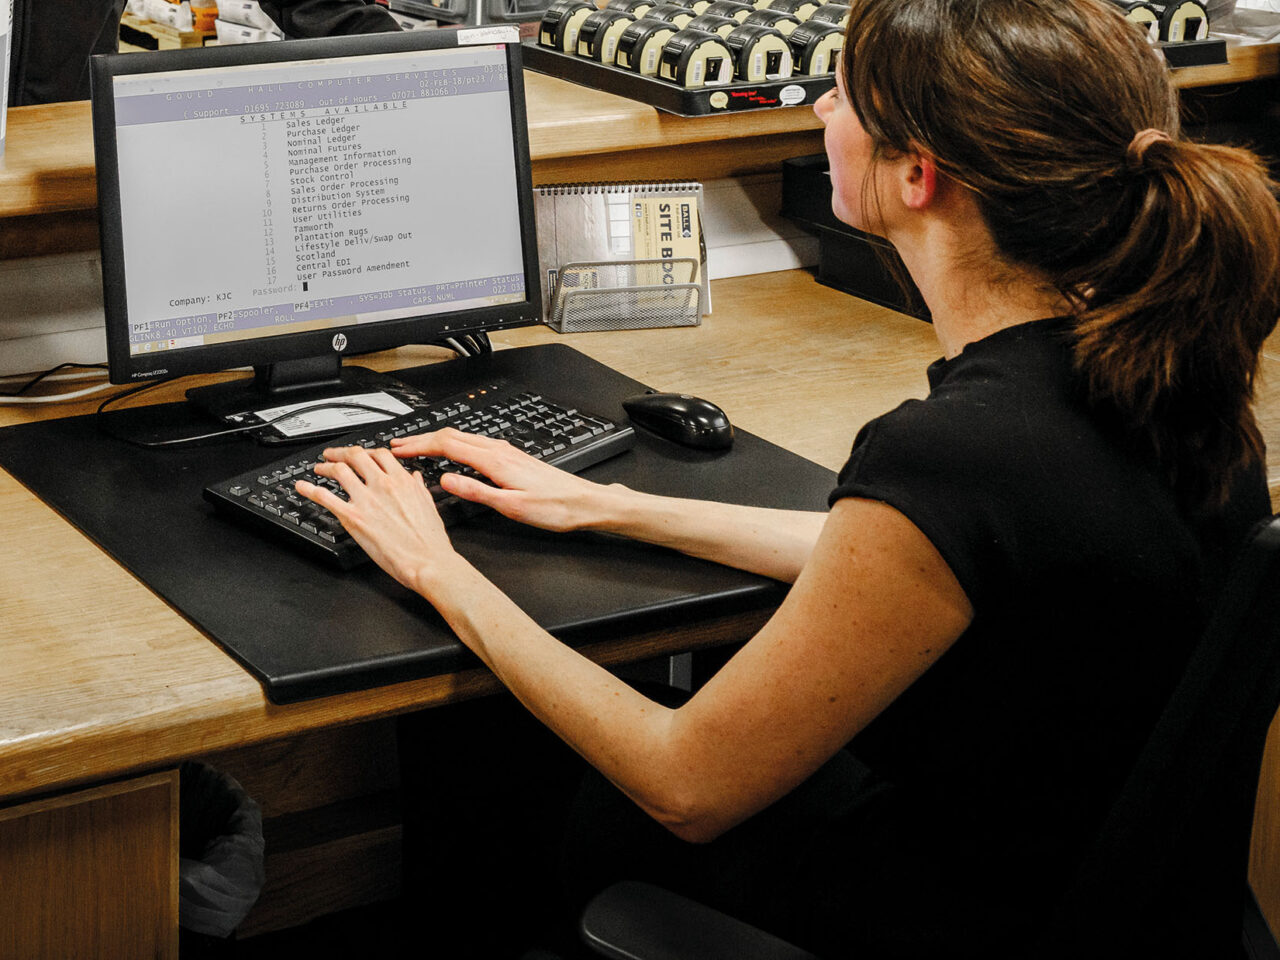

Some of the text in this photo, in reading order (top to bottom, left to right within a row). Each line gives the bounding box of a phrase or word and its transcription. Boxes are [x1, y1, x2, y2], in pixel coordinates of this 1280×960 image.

[166, 70, 458, 101] GOULD HALL COMPUTER SERVICES
[194, 108, 229, 119] Support
[240, 101, 408, 124] SYSTEMS AVAILABLE
[286, 116, 346, 129] Sales Ledger
[287, 124, 361, 138] Purchase Ledger
[288, 134, 357, 147] Nominal Ledger
[288, 144, 362, 157] Nominal Futures
[288, 150, 397, 167] Management Information
[290, 157, 412, 176] Purchase Order Processing
[290, 172, 354, 186] Stock Control
[291, 177, 399, 195] Sales Order Processing
[292, 188, 386, 205] Distribution System
[292, 194, 410, 214] Returns Order Processing
[293, 209, 362, 223] User Utilities
[659, 204, 673, 242] SITE
[294, 222, 334, 233] Tamworth
[294, 228, 369, 242] Plantation Rugs
[295, 232, 413, 252] Lifestyle Deliv/Swap Out
[296, 251, 336, 262] Scotland
[296, 258, 351, 272] Central EDI
[297, 260, 410, 281] User Password Amendment
[492, 275, 520, 285] Status
[170, 295, 211, 308] Company:
[216, 292, 232, 302] KJC
[274, 314, 295, 323] ROLL
[412, 296, 433, 305] CAPS
[334, 335, 346, 351] hp
